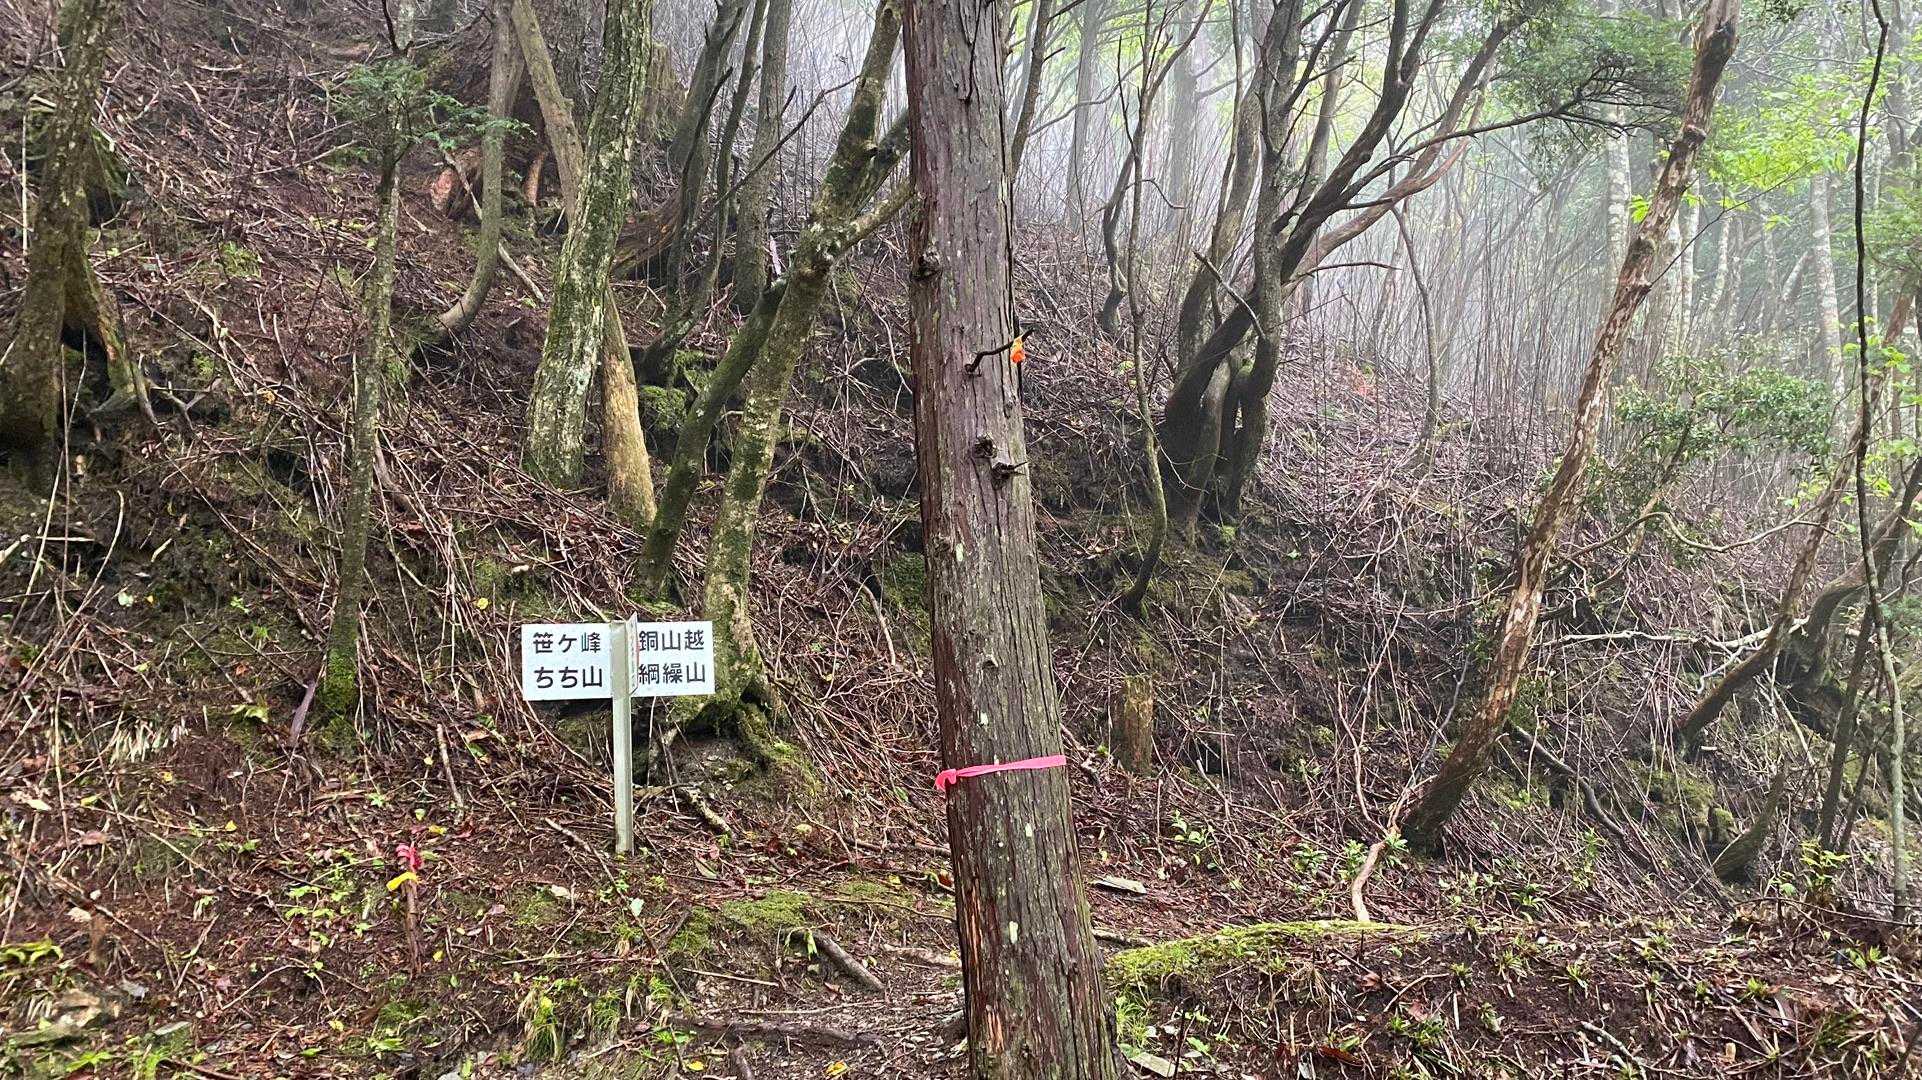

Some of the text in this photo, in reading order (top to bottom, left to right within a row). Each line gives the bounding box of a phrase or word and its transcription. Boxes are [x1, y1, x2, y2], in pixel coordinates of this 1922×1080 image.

[639, 629, 704, 651] 銅山越
[534, 666, 602, 688] ちち山
[638, 662, 705, 684] 綱繰山
